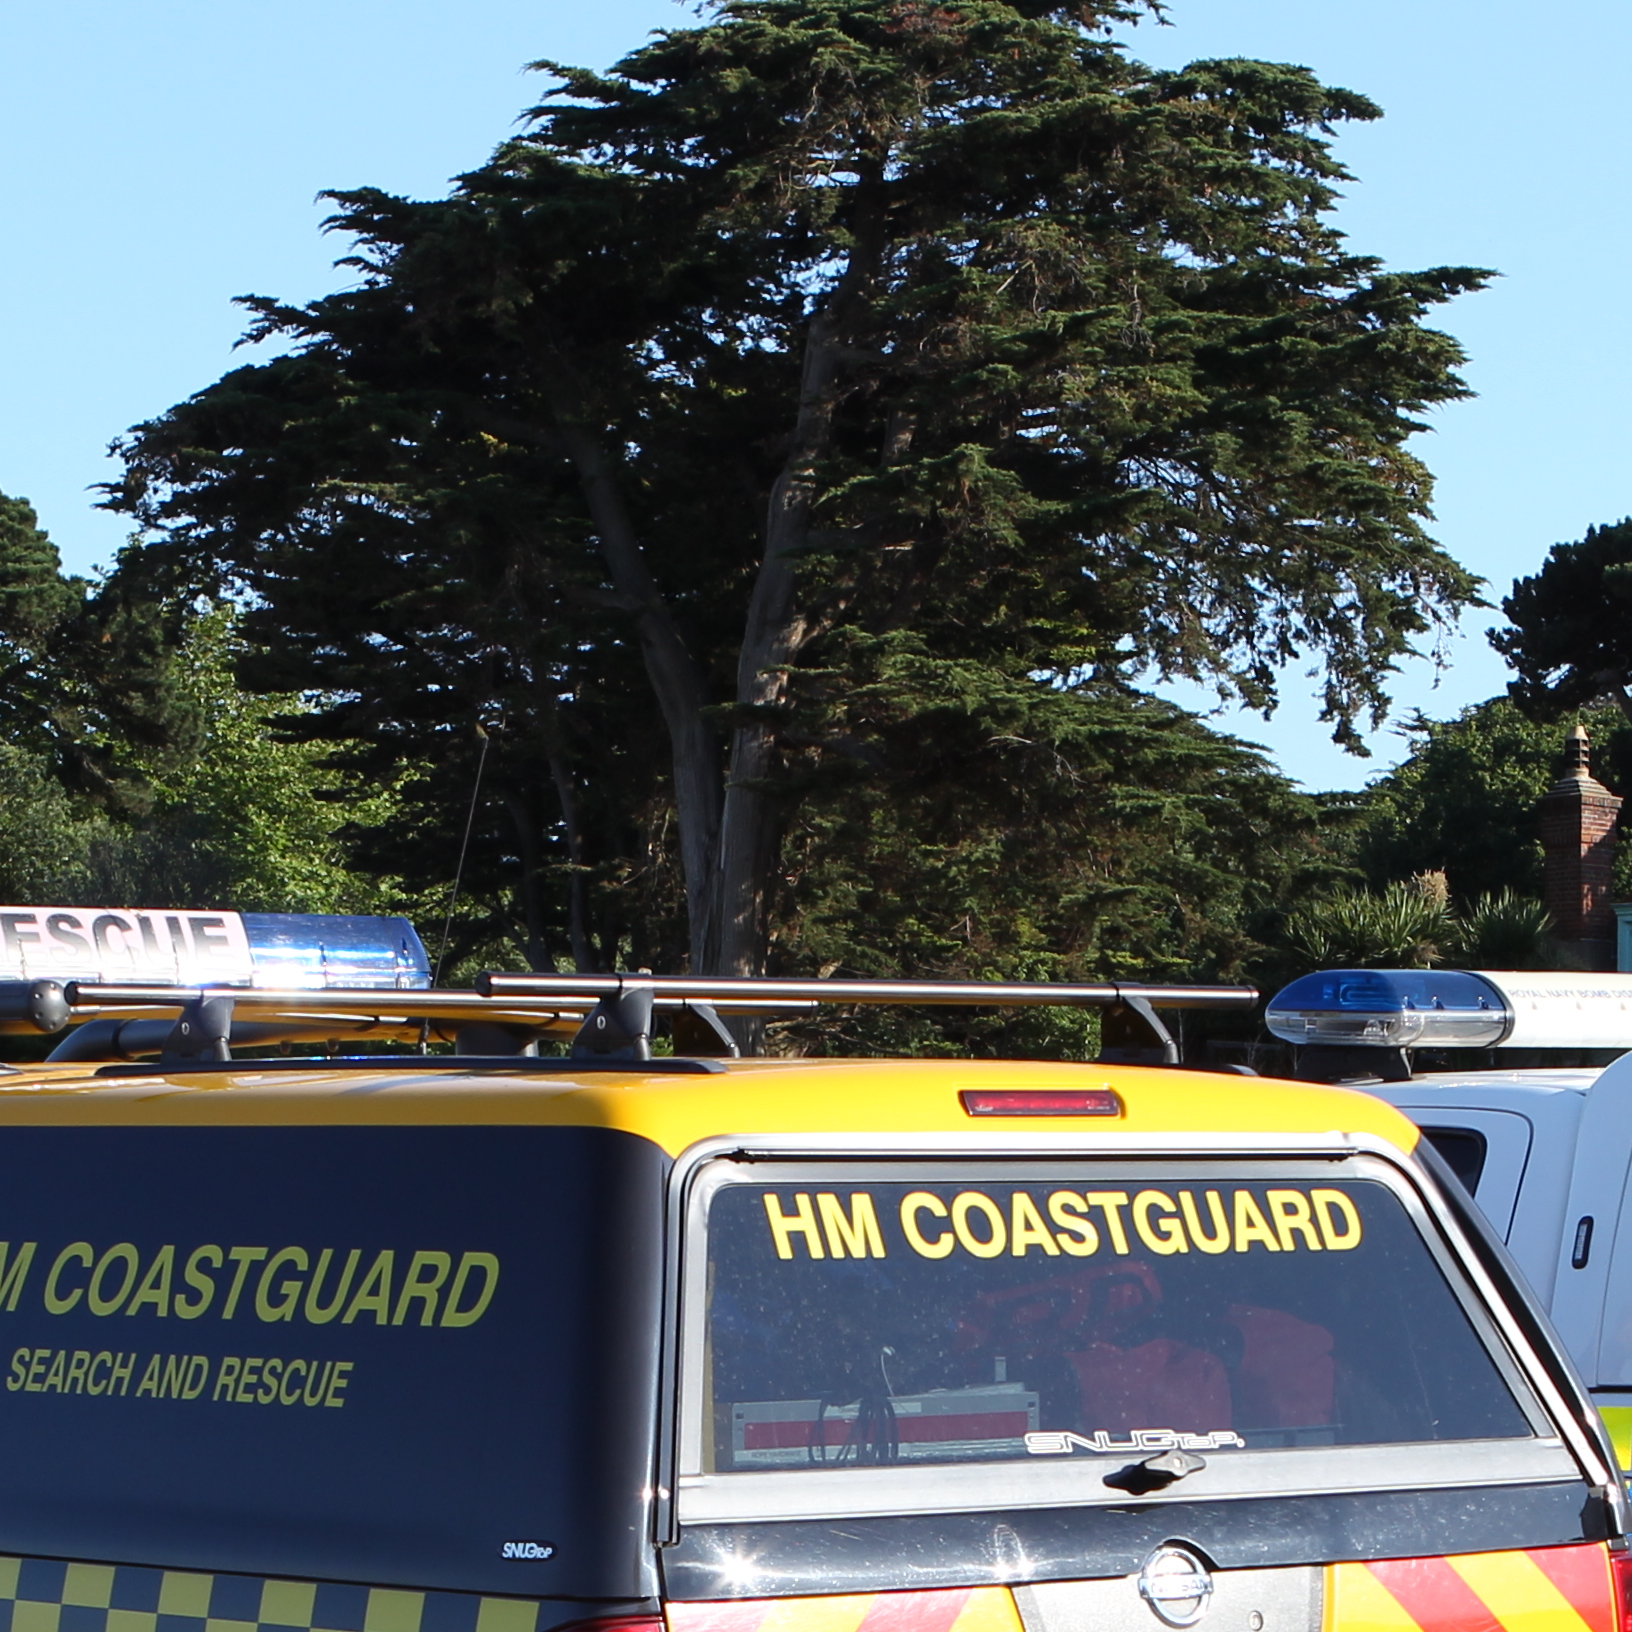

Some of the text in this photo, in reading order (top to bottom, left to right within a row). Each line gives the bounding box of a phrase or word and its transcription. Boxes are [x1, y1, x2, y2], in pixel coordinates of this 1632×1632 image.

[1507, 988, 1547, 998] ROYAL
[1546, 988, 1576, 998] NAVY
[1576, 988, 1611, 998] BOMB
[762, 1188, 1362, 1260] HM COASTGUARD
[45, 1241, 501, 1328] COASTGUARD
[6, 1346, 354, 1408] SEARCH AND RESCUE
